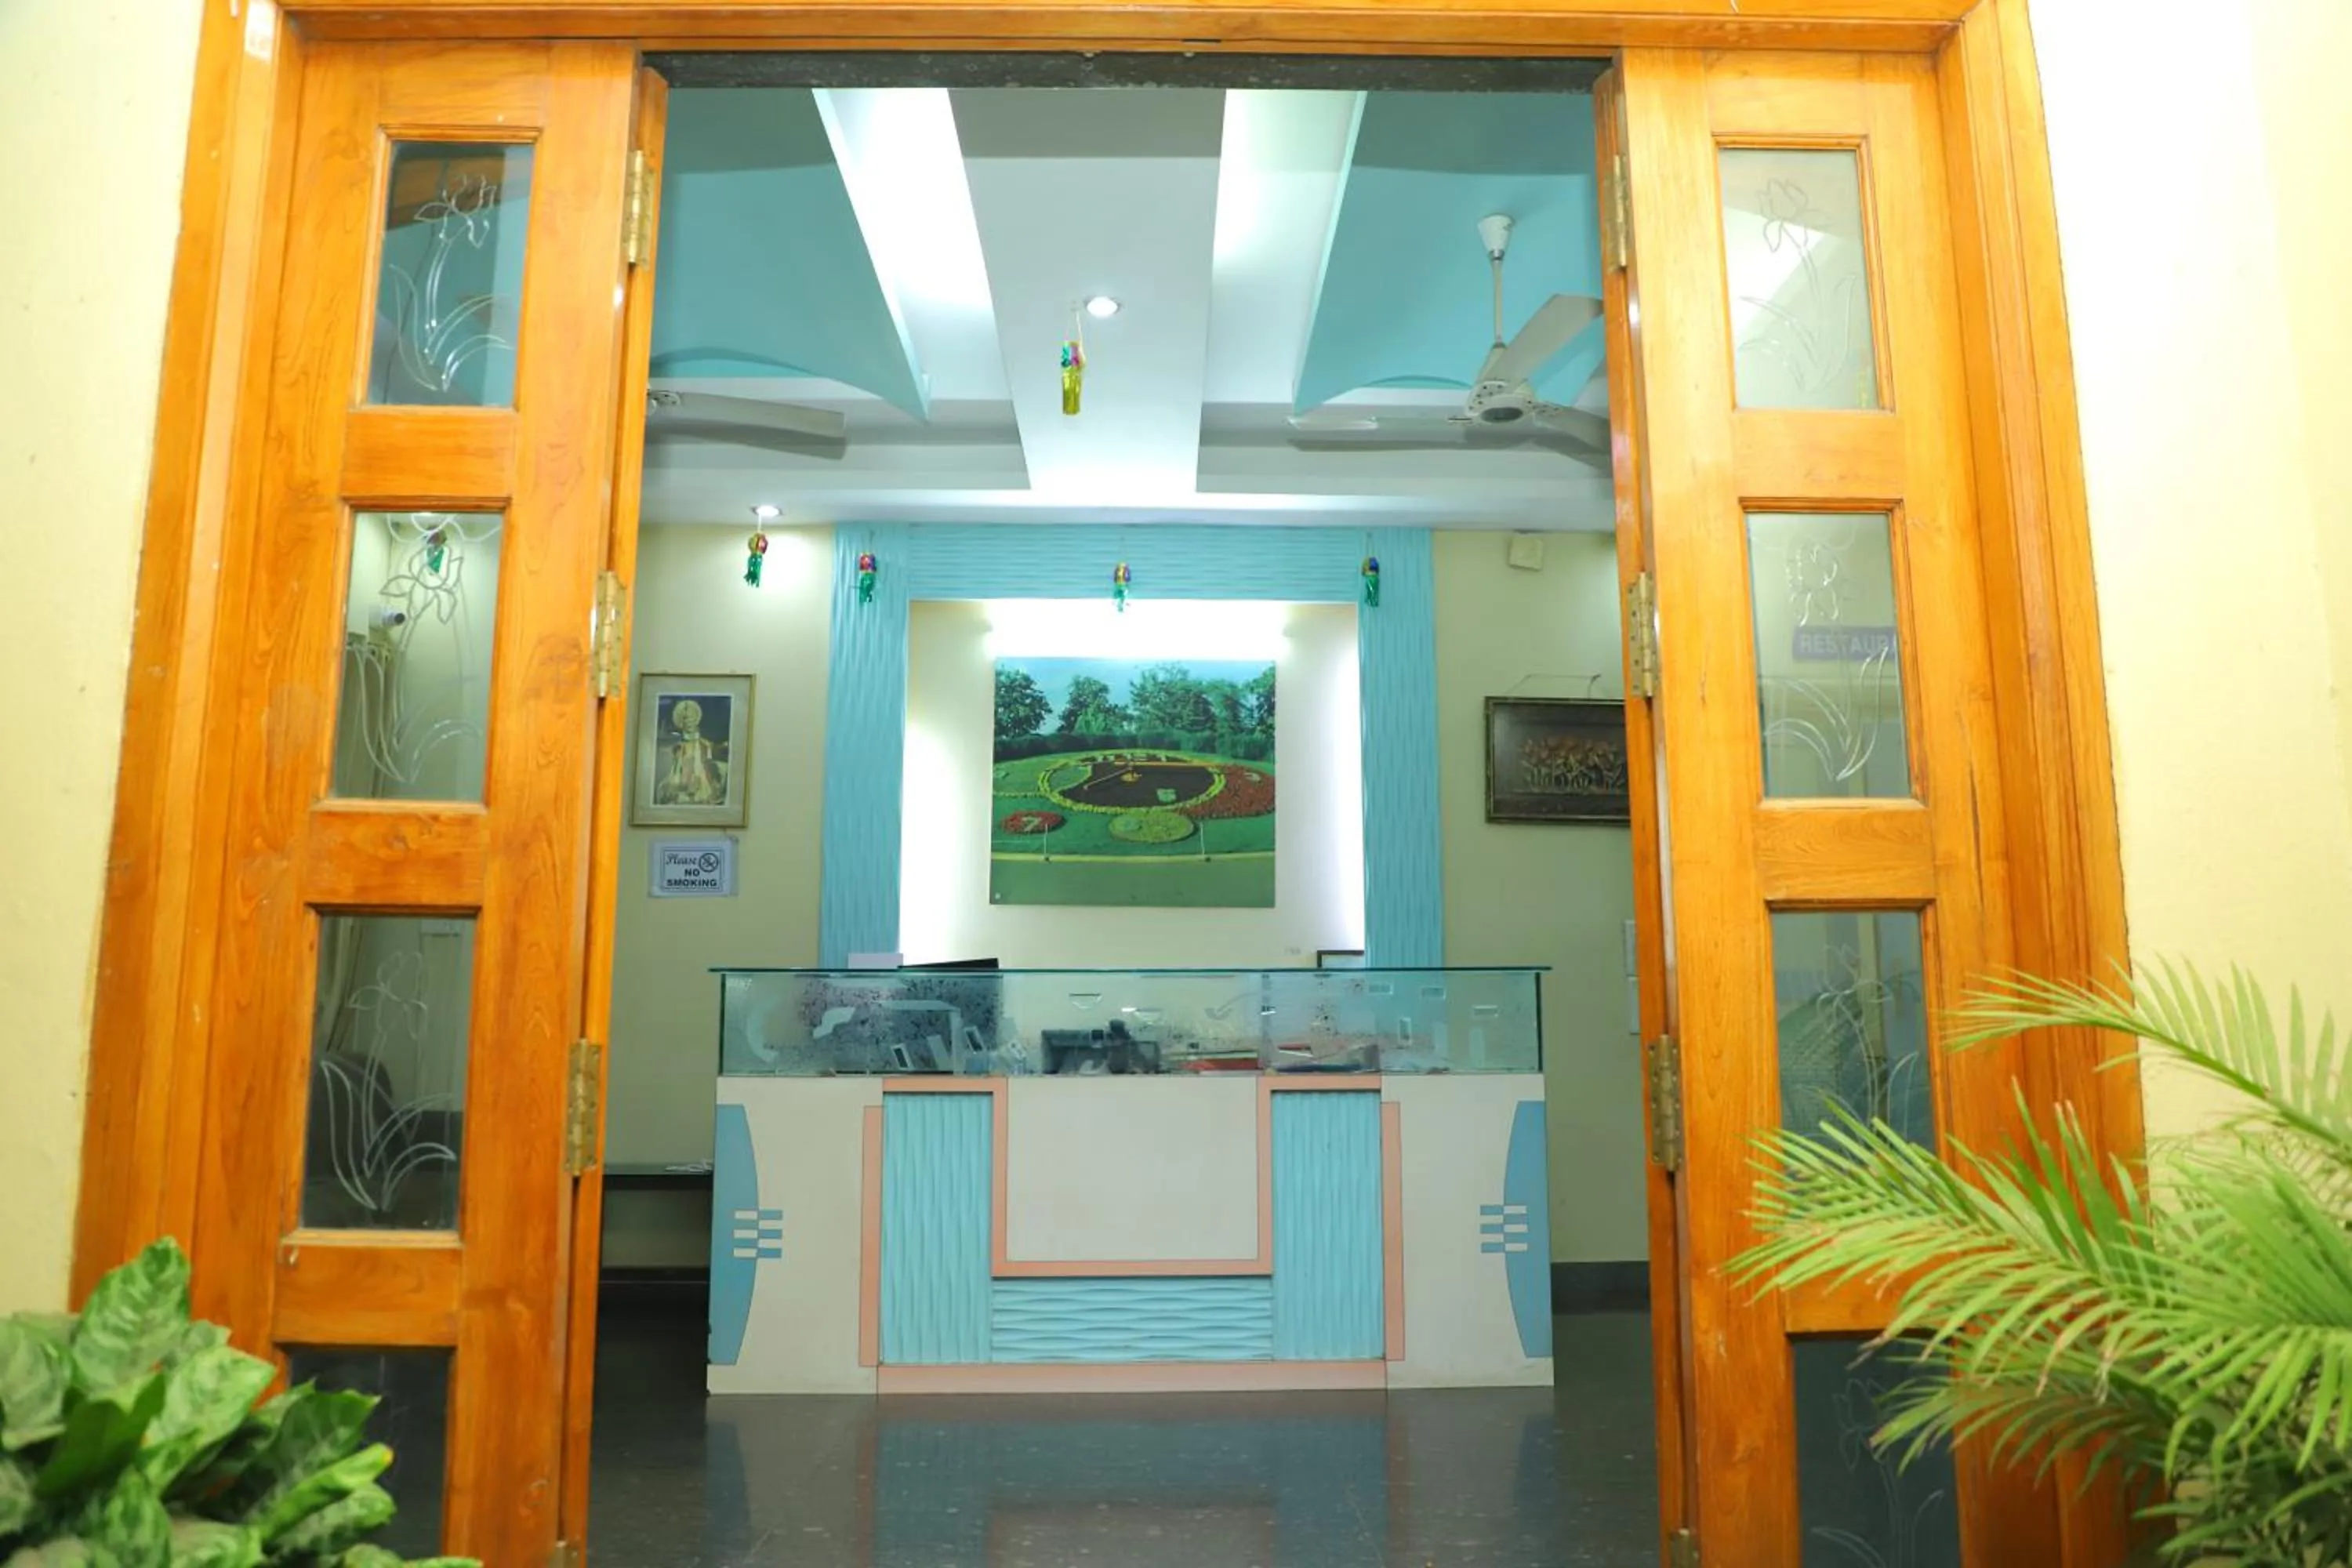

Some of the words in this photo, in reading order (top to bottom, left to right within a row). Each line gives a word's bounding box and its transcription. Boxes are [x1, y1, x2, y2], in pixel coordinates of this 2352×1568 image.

[1800, 633, 1894, 654] RESTAUR
[684, 868, 700, 877] NO
[666, 878, 717, 887] SMOKING
